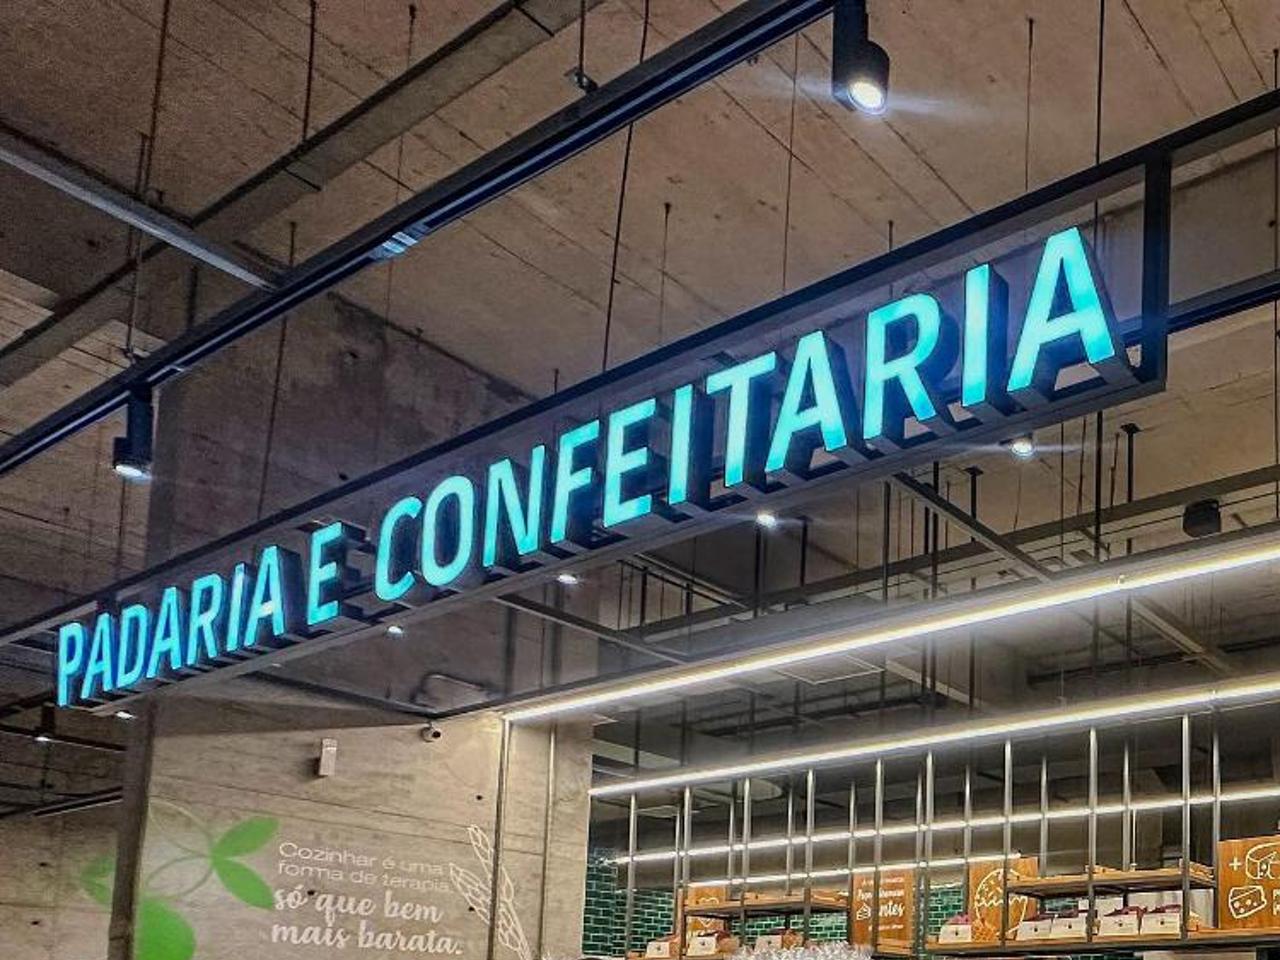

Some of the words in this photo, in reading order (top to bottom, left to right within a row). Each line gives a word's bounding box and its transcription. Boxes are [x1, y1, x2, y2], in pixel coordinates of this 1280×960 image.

[58, 546, 285, 707] PADARIA
[306, 521, 343, 626] E
[375, 227, 1116, 601] CONFEITARIA
[278, 860, 343, 880] forma
[350, 870, 376, 885] de
[279, 842, 377, 867] Cozinhar
[382, 855, 396, 869] é
[400, 862, 443, 875] uma
[274, 885, 308, 910] só
[315, 892, 377, 927] que
[384, 889, 444, 923] bem
[271, 923, 350, 948] mais
[358, 919, 464, 954] barata.
